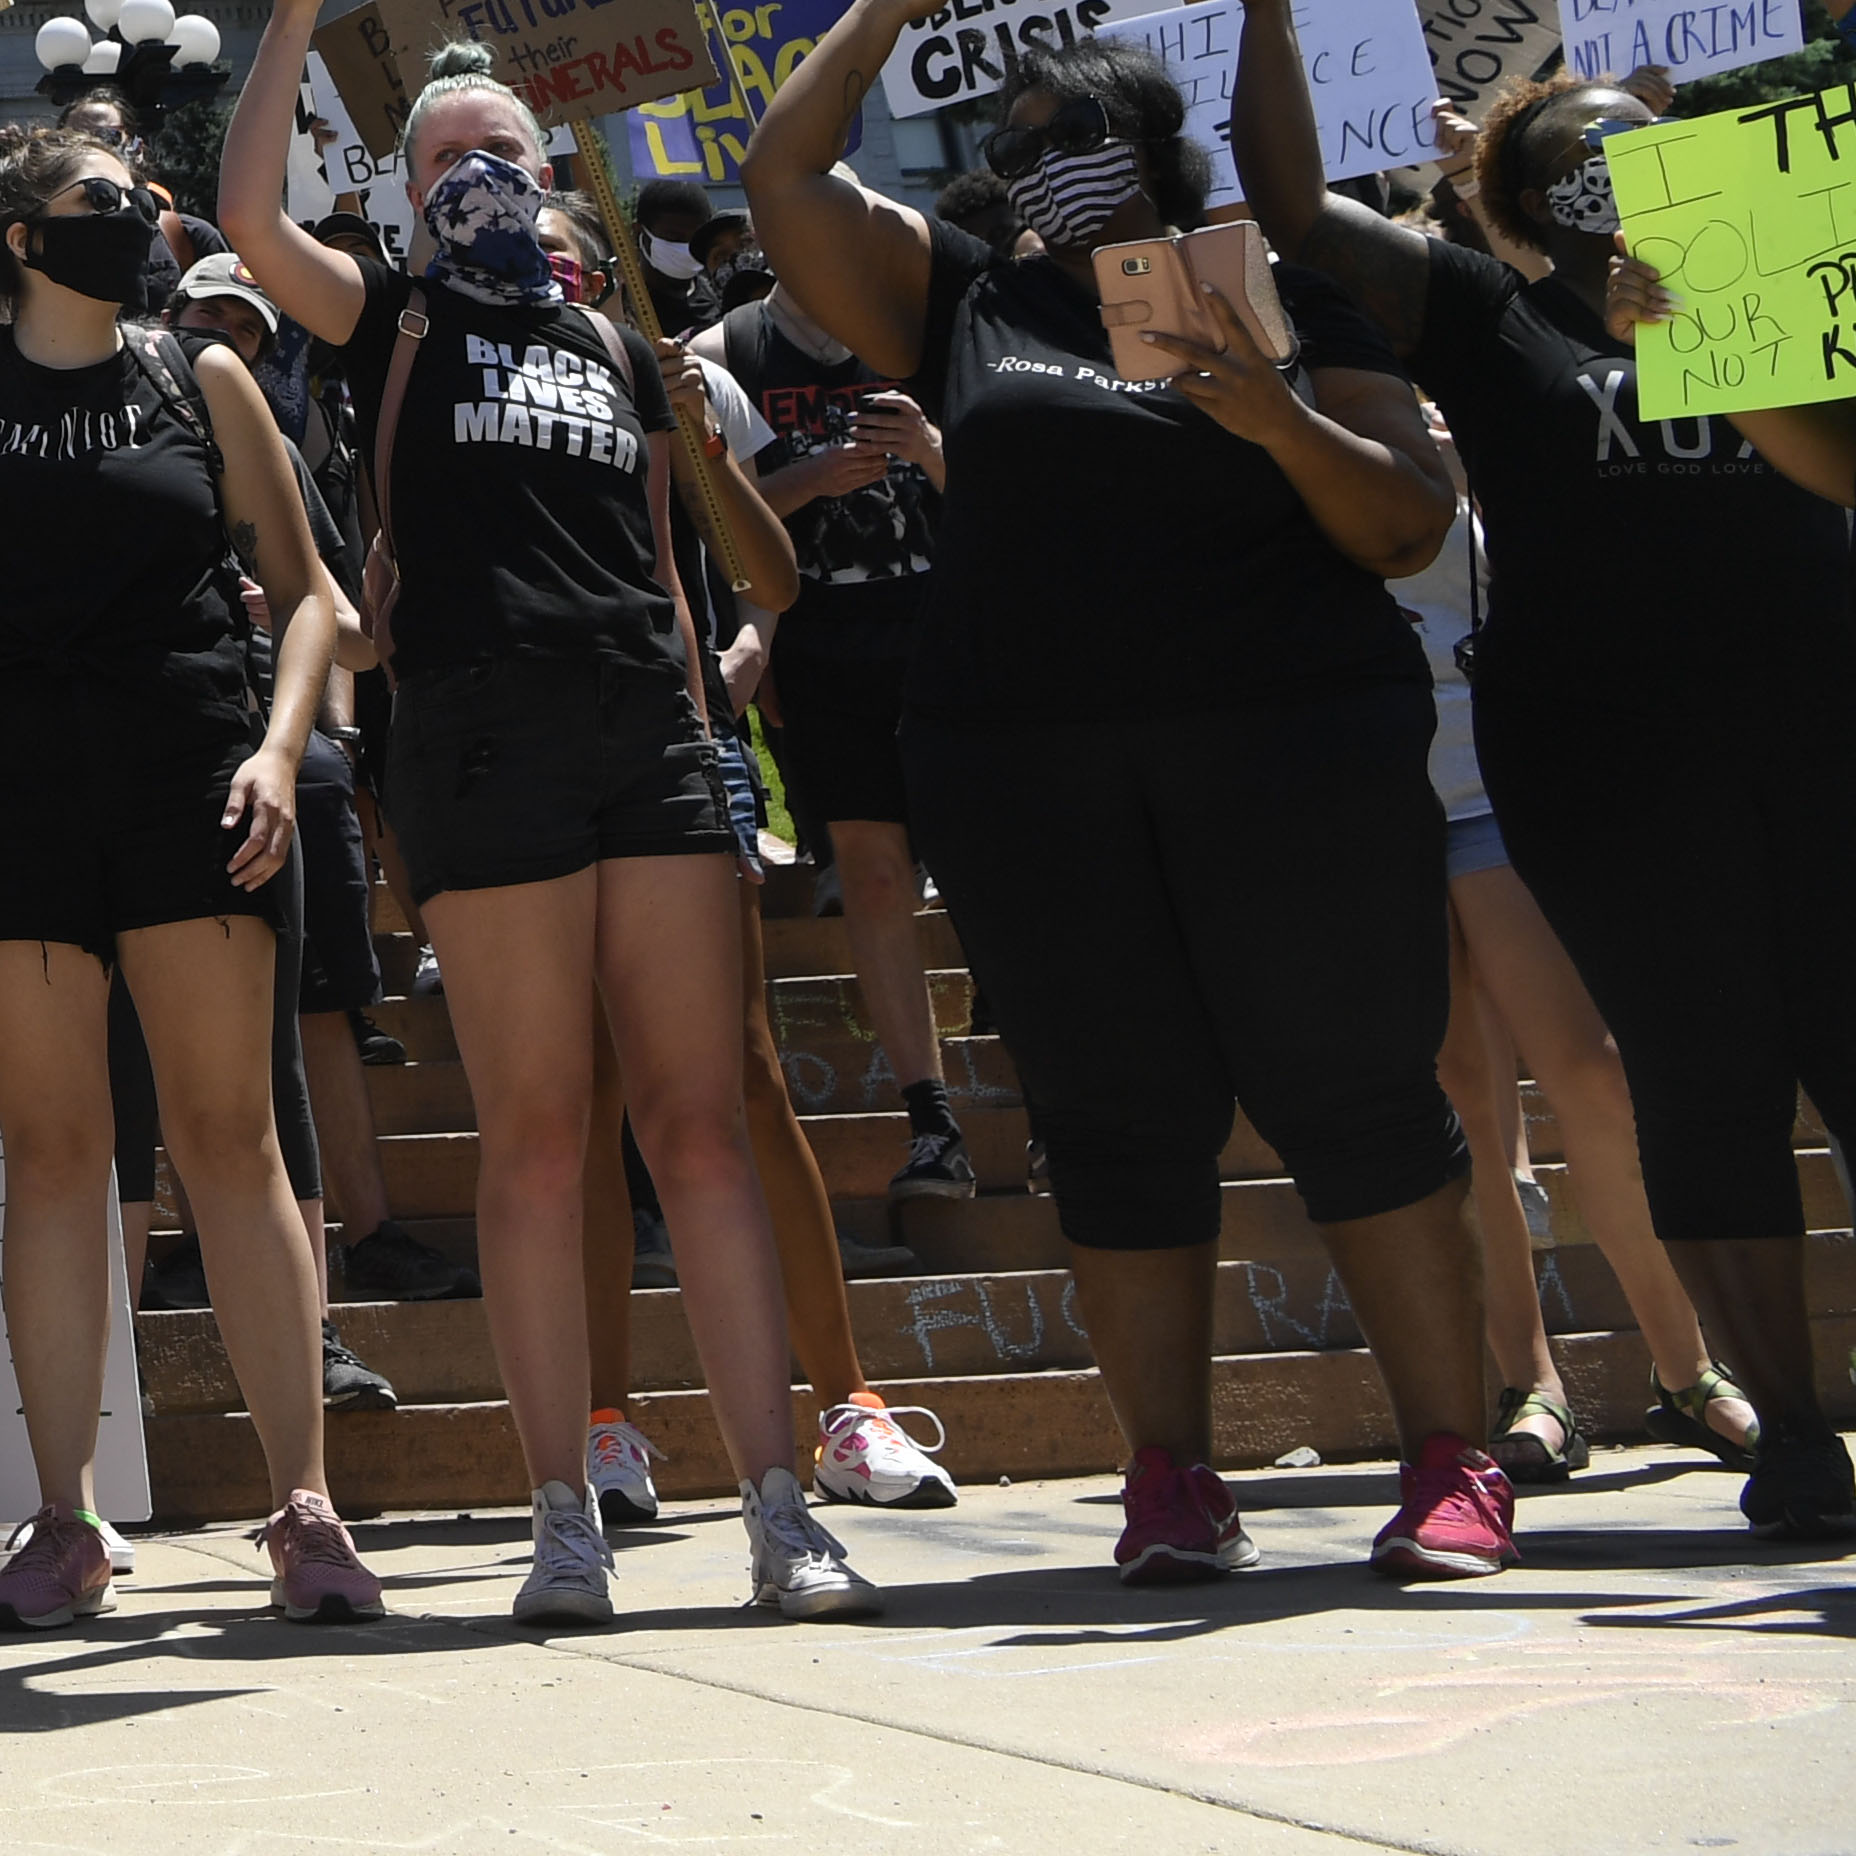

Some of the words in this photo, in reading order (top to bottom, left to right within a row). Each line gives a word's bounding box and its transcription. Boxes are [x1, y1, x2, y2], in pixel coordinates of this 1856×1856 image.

[508, 36, 579, 72] their
[1669, 293, 1787, 353] OUR
[466, 333, 618, 399] BLACK
[482, 366, 613, 422] LIVES
[1684, 336, 1793, 405] NOT
[454, 402, 637, 474] MATTER
